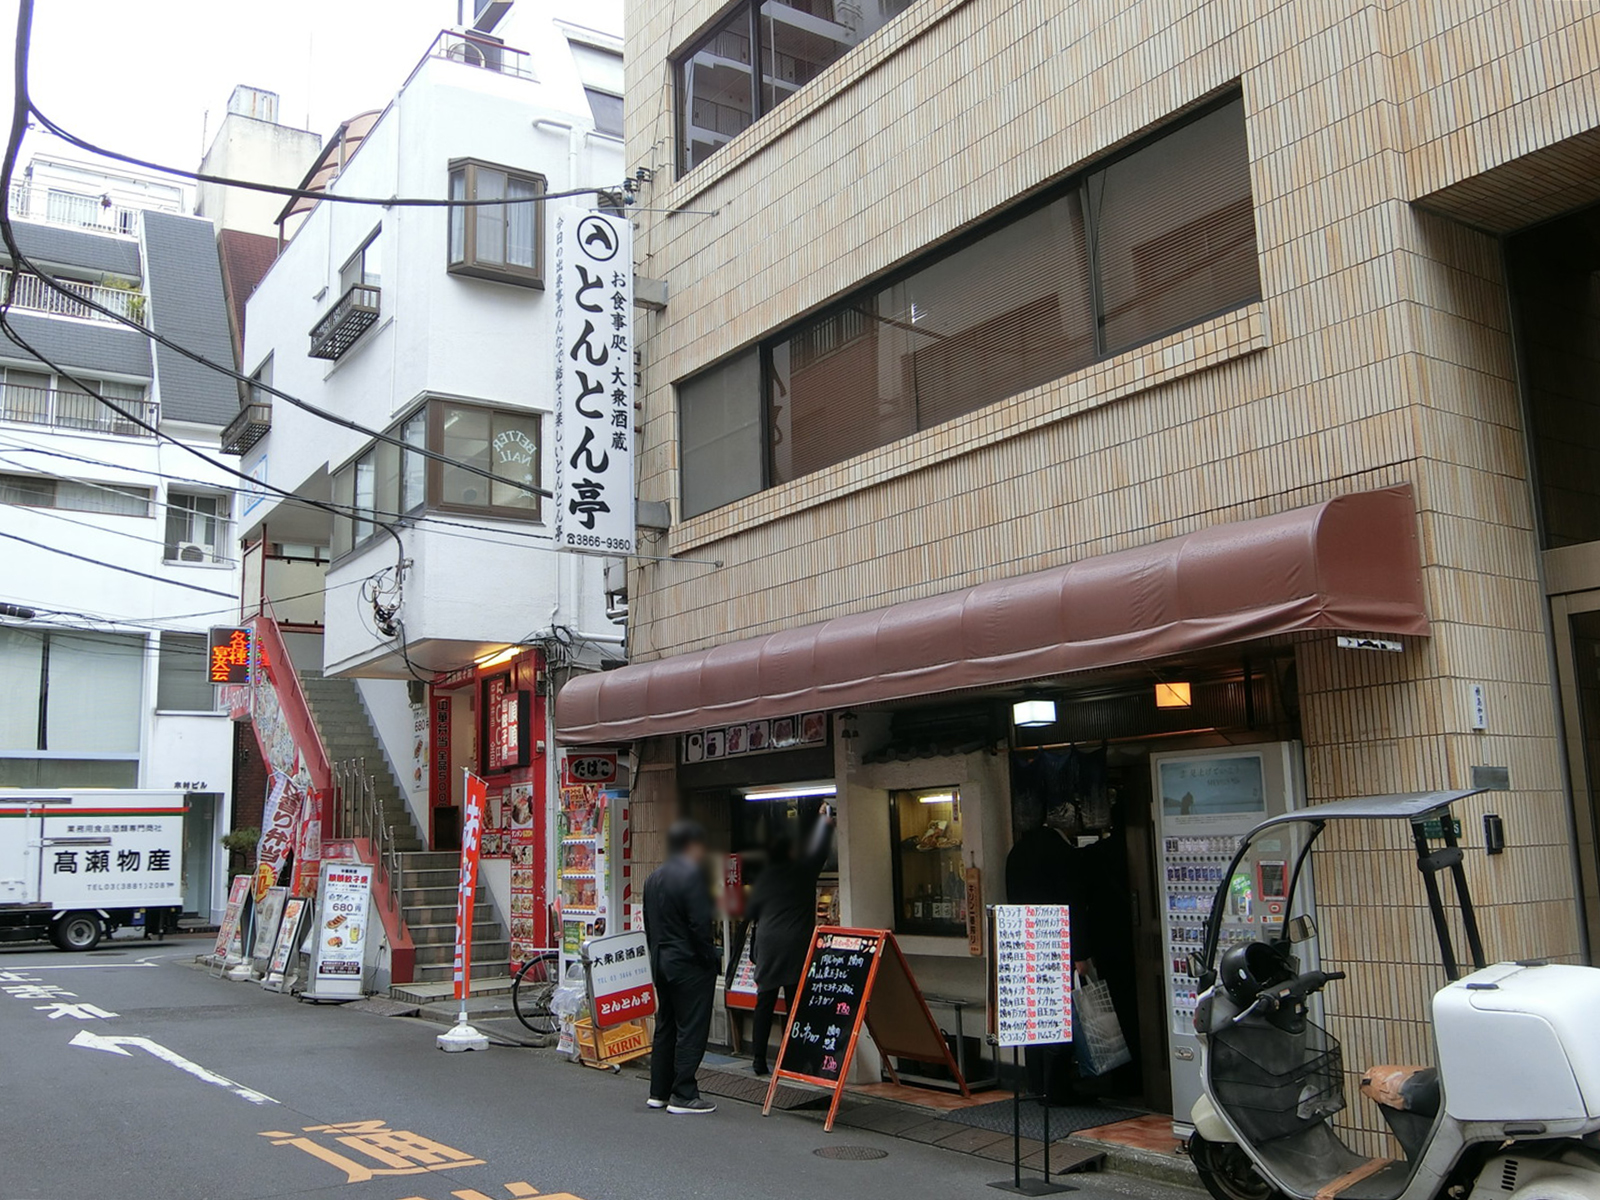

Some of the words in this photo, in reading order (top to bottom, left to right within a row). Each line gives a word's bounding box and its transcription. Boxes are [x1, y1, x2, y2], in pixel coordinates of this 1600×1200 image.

[569, 264, 611, 530] とんとん亭
[230, 631, 248, 665] 各種
[212, 646, 231, 680] 宴会
[574, 760, 609, 777] たばこ
[593, 945, 647, 968] 大衆居酒屋
[601, 992, 651, 1014] とんとん亭
[792, 1021, 800, 1038] B
[608, 1036, 642, 1056] KIRIN
[257, 1120, 487, 1183] 通
